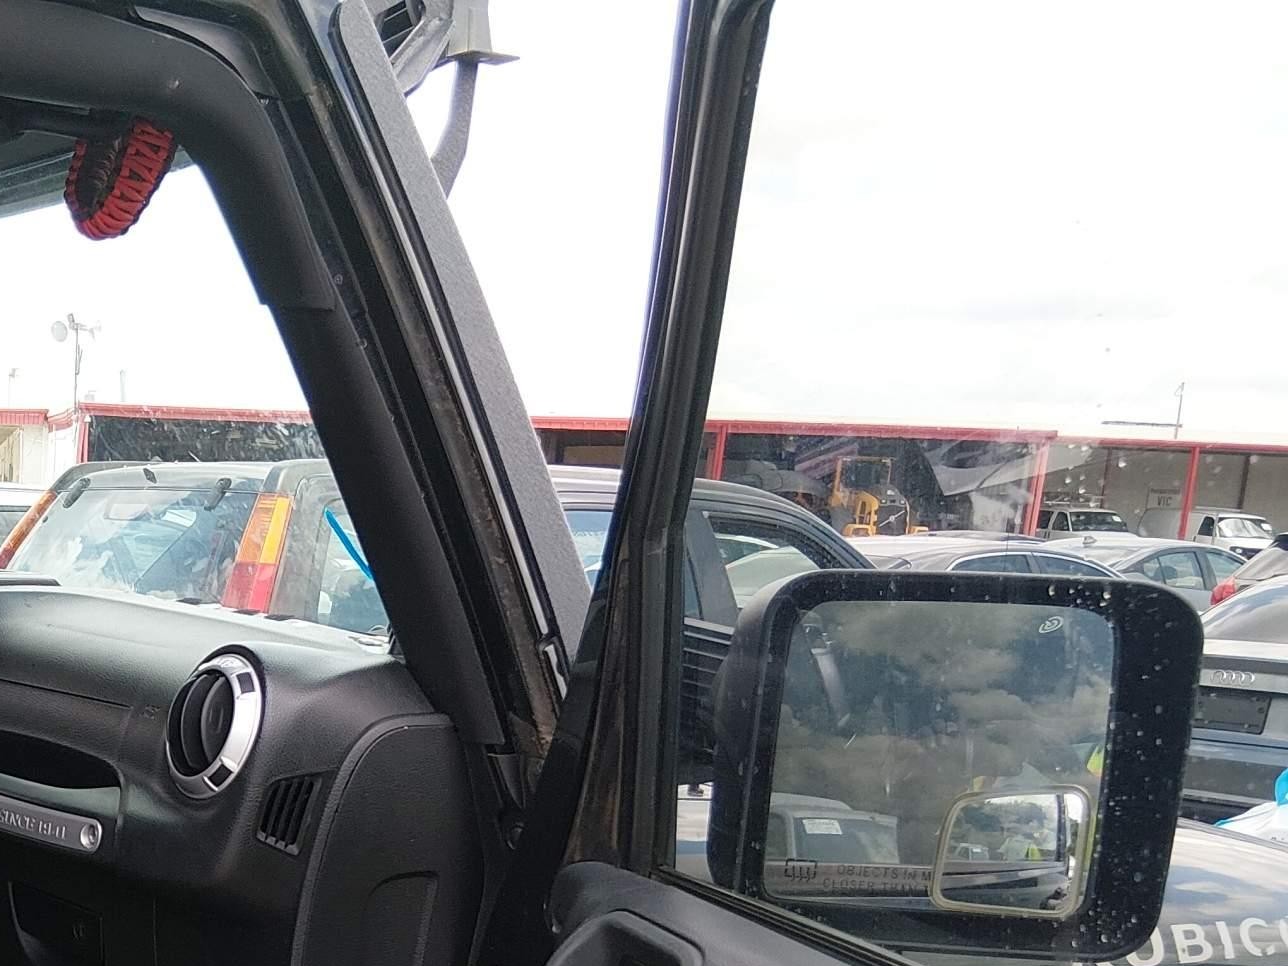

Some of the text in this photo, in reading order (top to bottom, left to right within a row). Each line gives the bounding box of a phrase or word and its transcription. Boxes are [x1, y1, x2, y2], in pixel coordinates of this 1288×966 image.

[837, 864, 918, 880] OBJECTS IN
[822, 878, 874, 890] CLOSER
